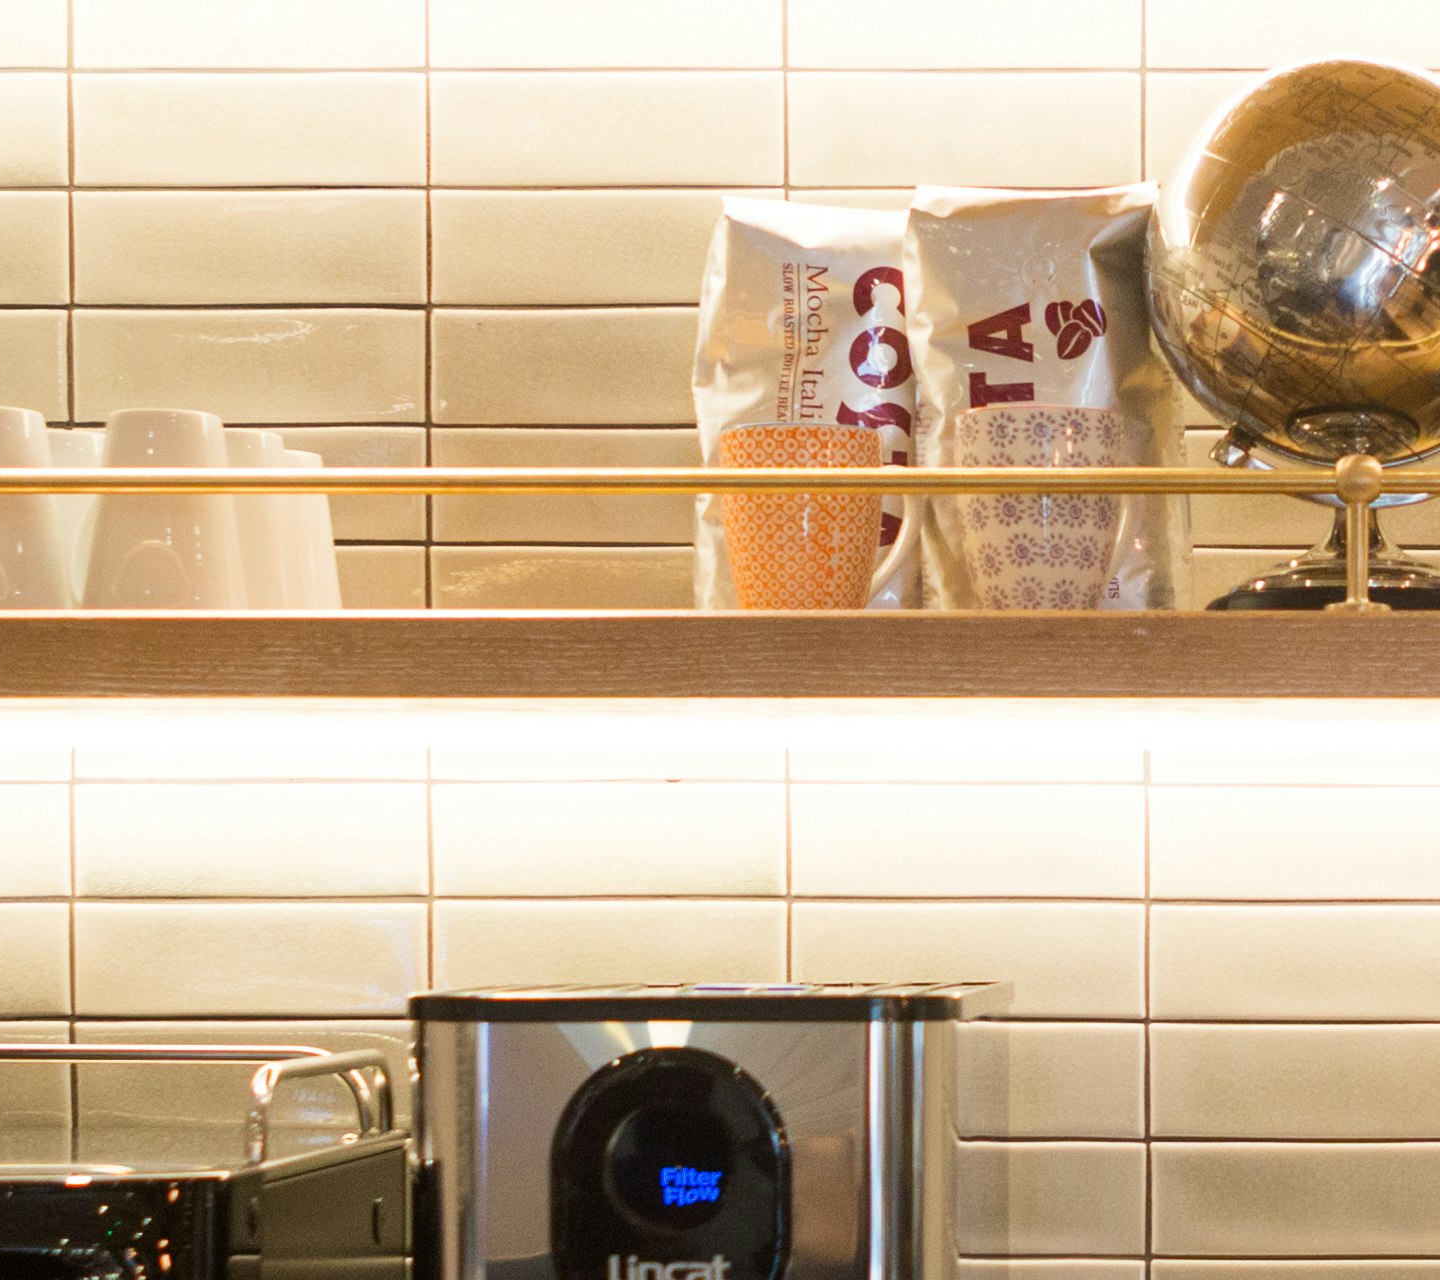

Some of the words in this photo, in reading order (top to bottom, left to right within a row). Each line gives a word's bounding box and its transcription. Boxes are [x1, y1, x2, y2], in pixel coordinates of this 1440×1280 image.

[783, 263, 793, 294] SLOW
[783, 298, 795, 350] ROASTED
[806, 264, 829, 357] Mocha
[778, 353, 794, 393] COFFEE
[800, 369, 824, 421] Itali
[660, 1167, 723, 1187] Filter
[663, 1185, 720, 1207] Flow
